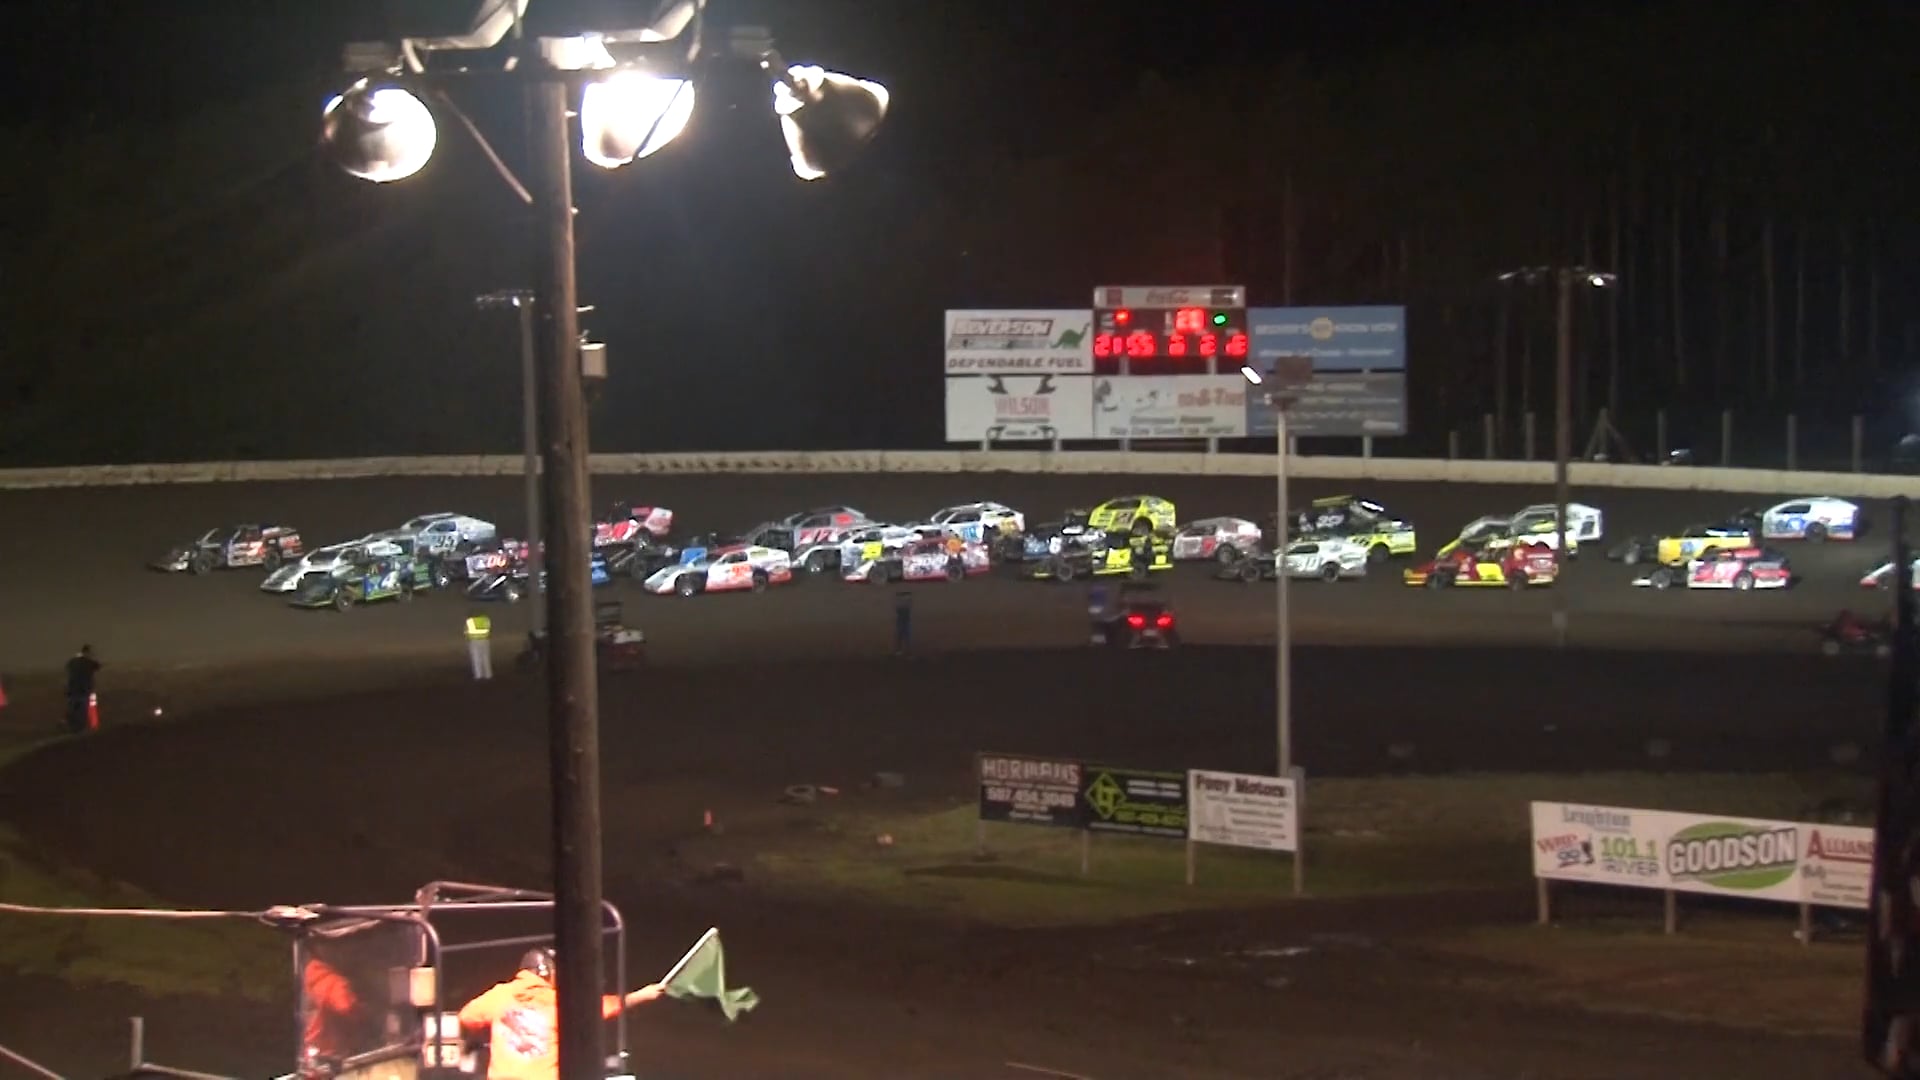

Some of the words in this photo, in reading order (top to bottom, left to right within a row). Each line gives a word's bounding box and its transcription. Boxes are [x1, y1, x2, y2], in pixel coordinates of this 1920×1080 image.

[949, 358, 1043, 369] DEPENDABLE
[1048, 358, 1084, 369] FUEL
[1668, 828, 1796, 876] GOODSON
